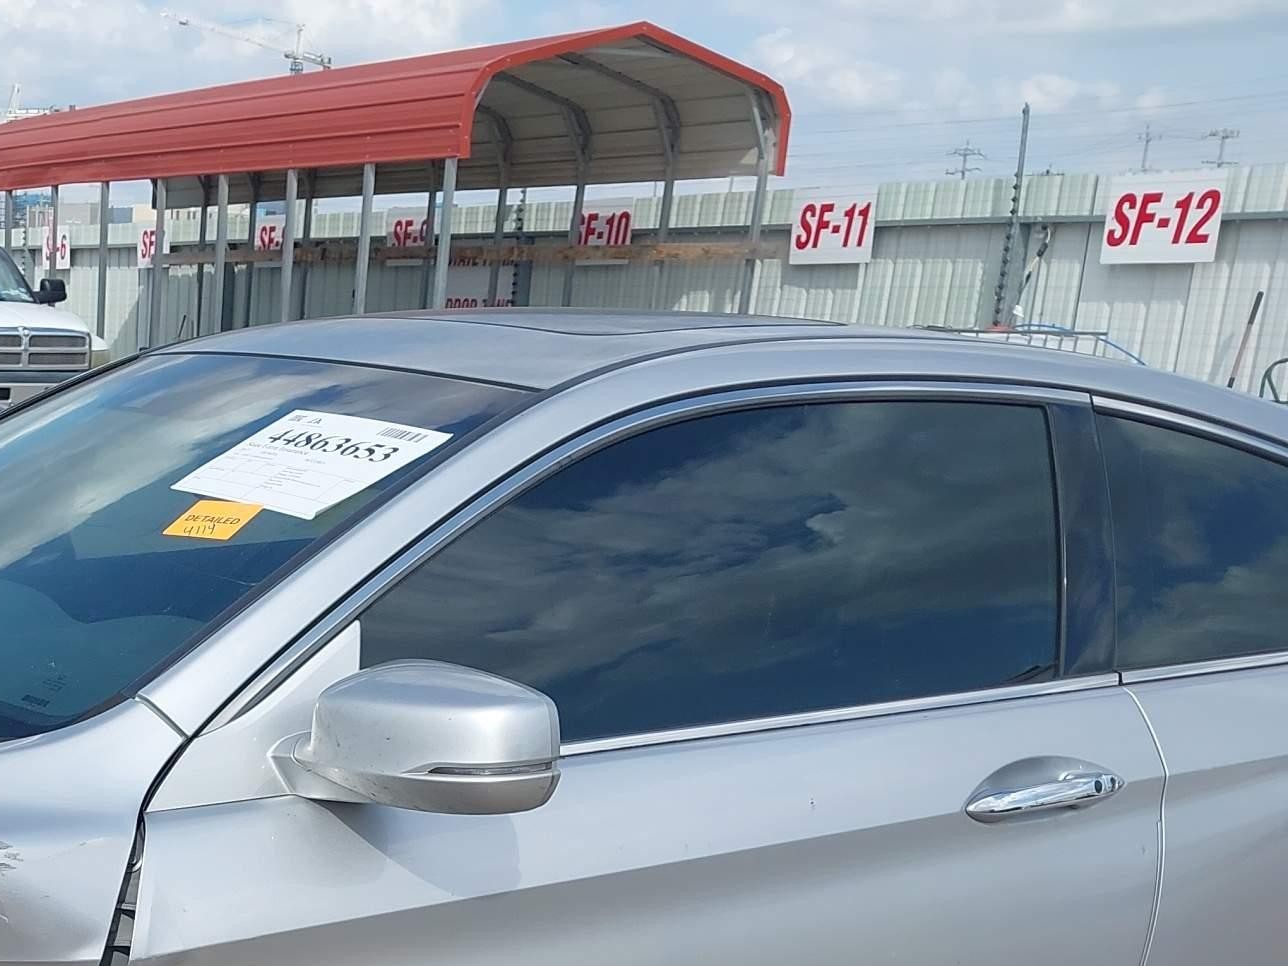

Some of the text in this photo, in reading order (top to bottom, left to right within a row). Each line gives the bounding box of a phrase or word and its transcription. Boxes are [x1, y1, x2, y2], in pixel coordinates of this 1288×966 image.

[795, 202, 872, 250] SF-11
[1106, 189, 1221, 247] SF-12
[268, 428, 400, 463] 44863653
[184, 514, 241, 525] DETAILED
